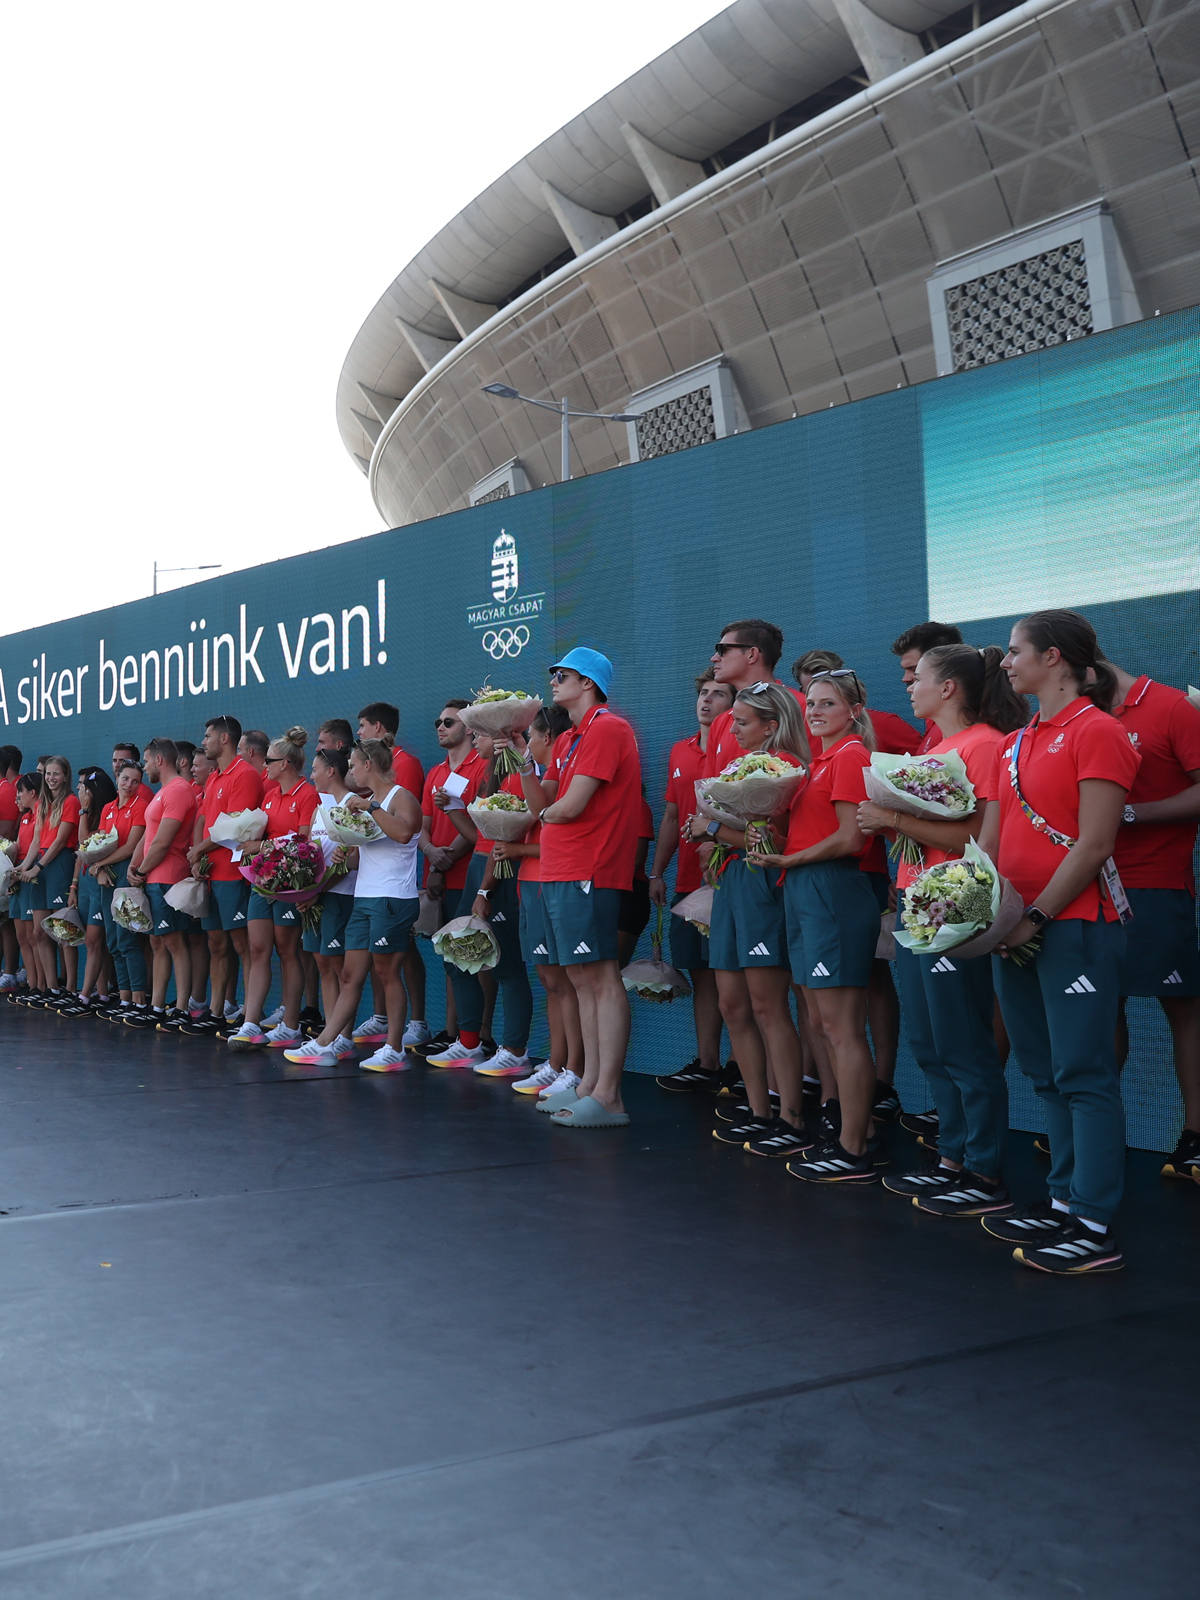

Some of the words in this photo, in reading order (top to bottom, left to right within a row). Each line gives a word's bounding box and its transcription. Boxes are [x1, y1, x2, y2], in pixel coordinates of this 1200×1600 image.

[17, 653, 89, 724] siker
[99, 603, 266, 711] bennünk
[277, 578, 388, 679] van!
[468, 607, 506, 623] MAGYAR
[508, 599, 544, 616] CSAPAT
